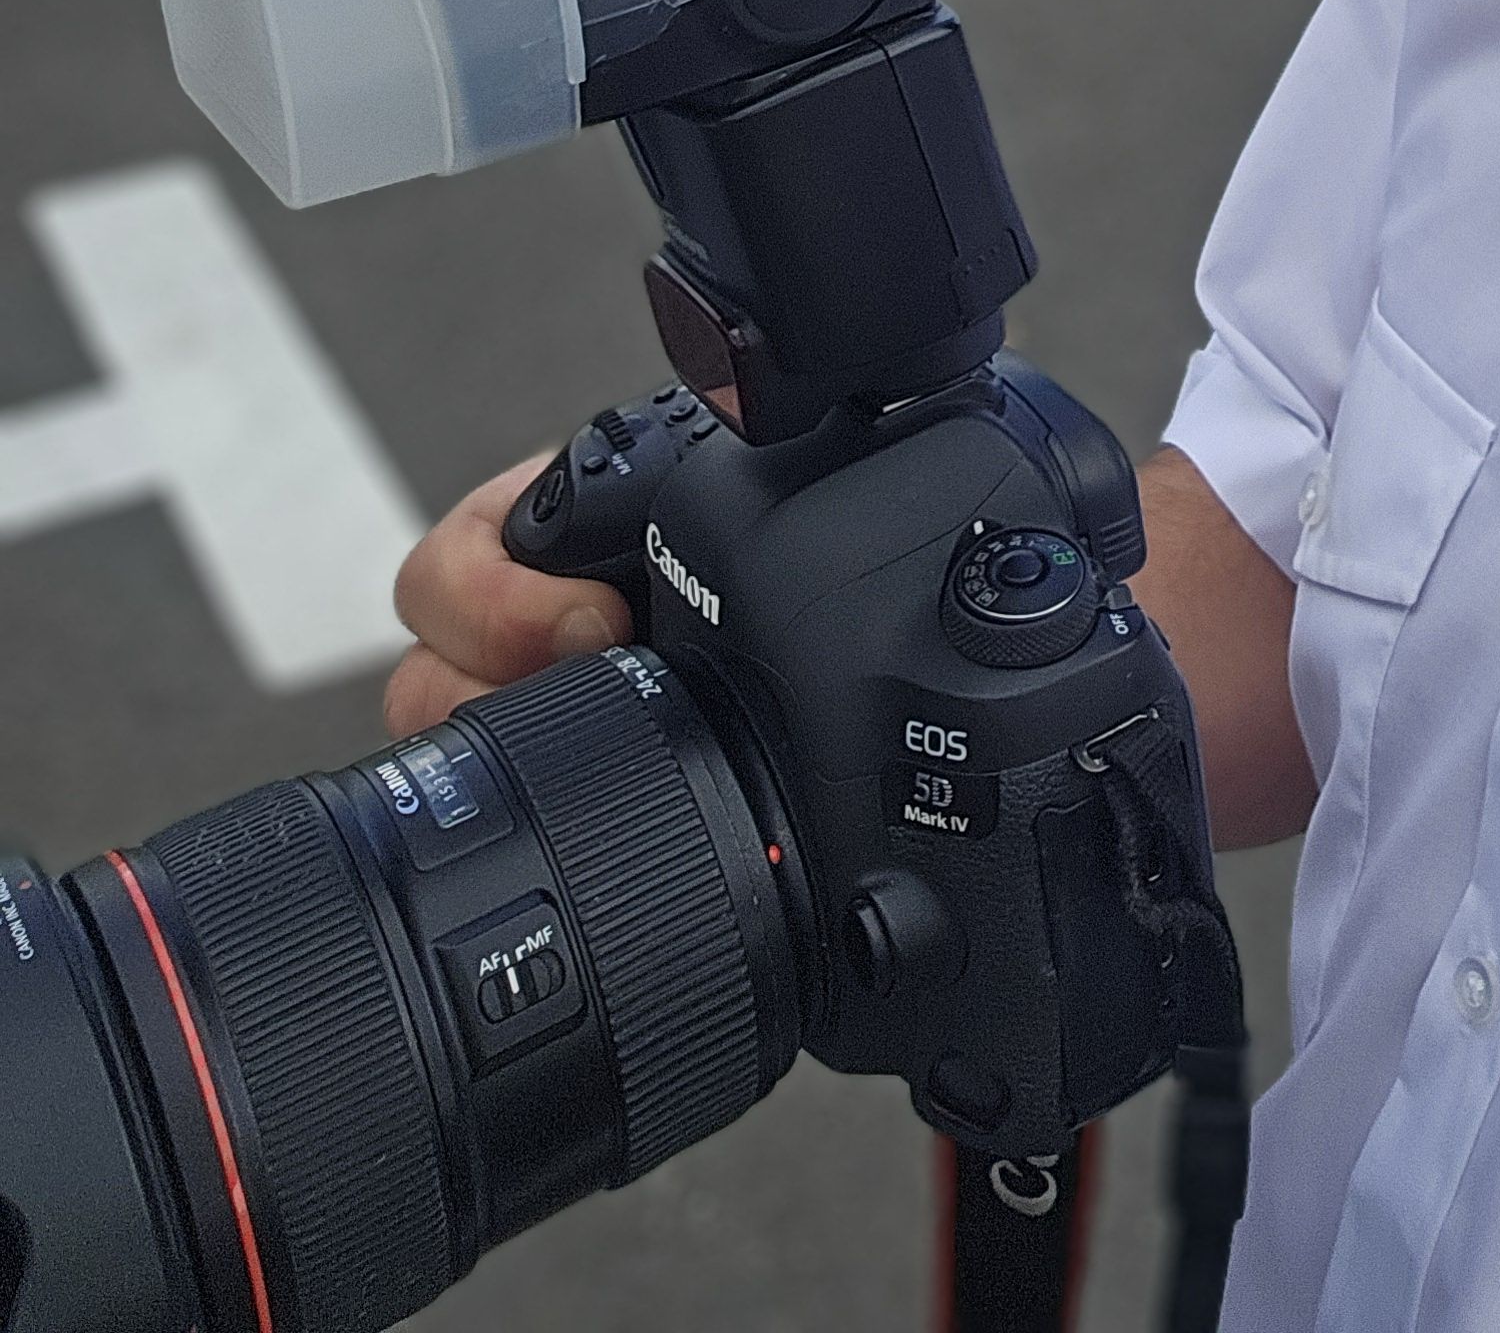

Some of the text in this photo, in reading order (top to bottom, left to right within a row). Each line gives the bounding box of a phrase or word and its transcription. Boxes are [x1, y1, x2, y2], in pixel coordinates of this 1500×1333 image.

[646, 522, 720, 626] Canon
[1109, 613, 1129, 635] OFF
[617, 656, 642, 673] 28
[636, 678, 663, 699] 24
[905, 720, 968, 761] EOS
[375, 761, 420, 815] Canon
[913, 772, 953, 807] 5D
[904, 804, 969, 832] Mark IV
[9, 919, 35, 960] CANON
[479, 924, 553, 978] AF MF
